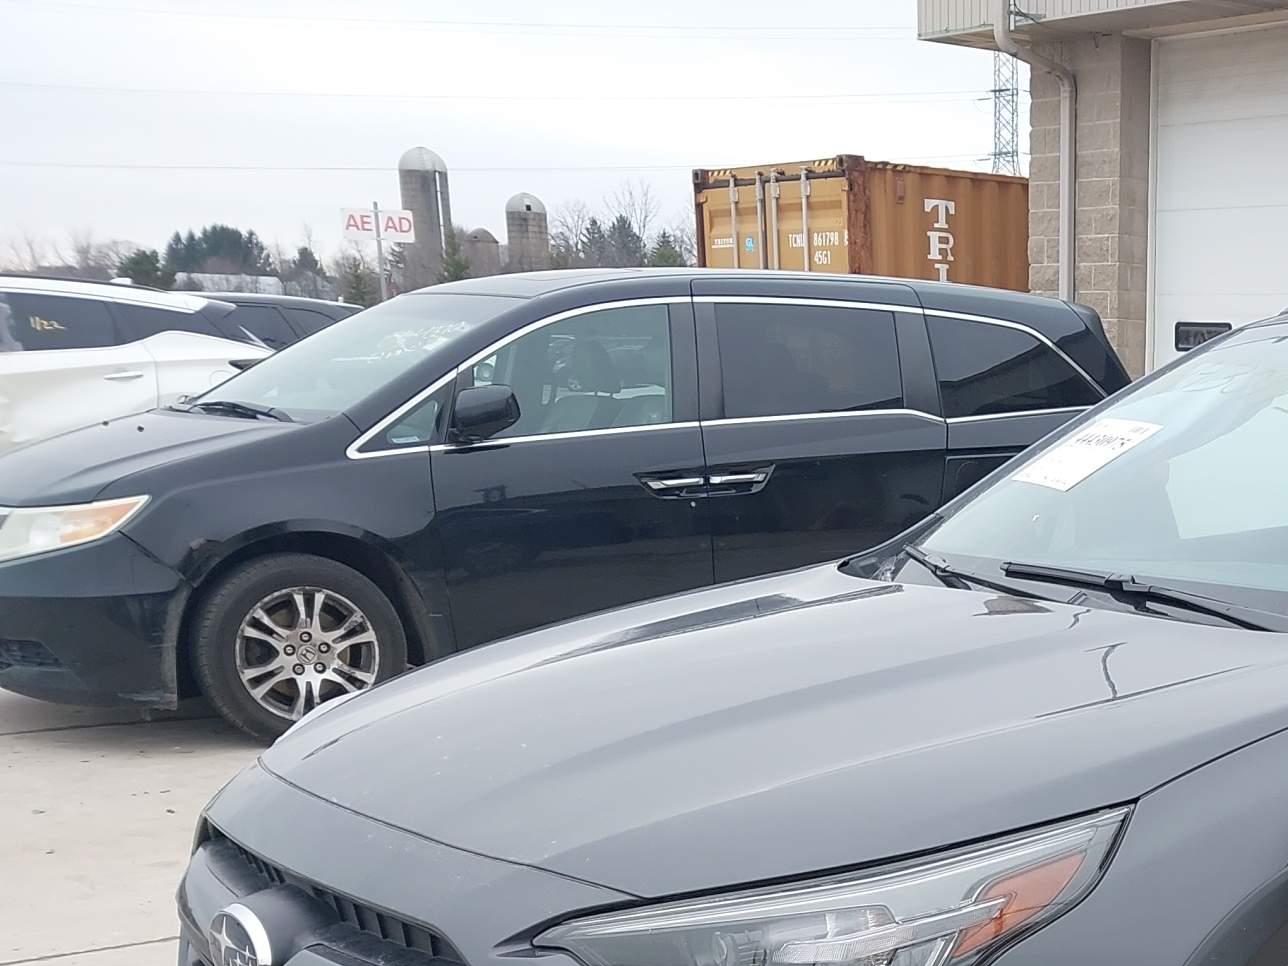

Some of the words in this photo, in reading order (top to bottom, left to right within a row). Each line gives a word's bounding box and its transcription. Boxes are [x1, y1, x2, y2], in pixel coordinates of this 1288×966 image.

[345, 214, 373, 231] AE
[384, 216, 412, 233] AD
[813, 231, 839, 247] 861798
[814, 250, 831, 265] 45G1
